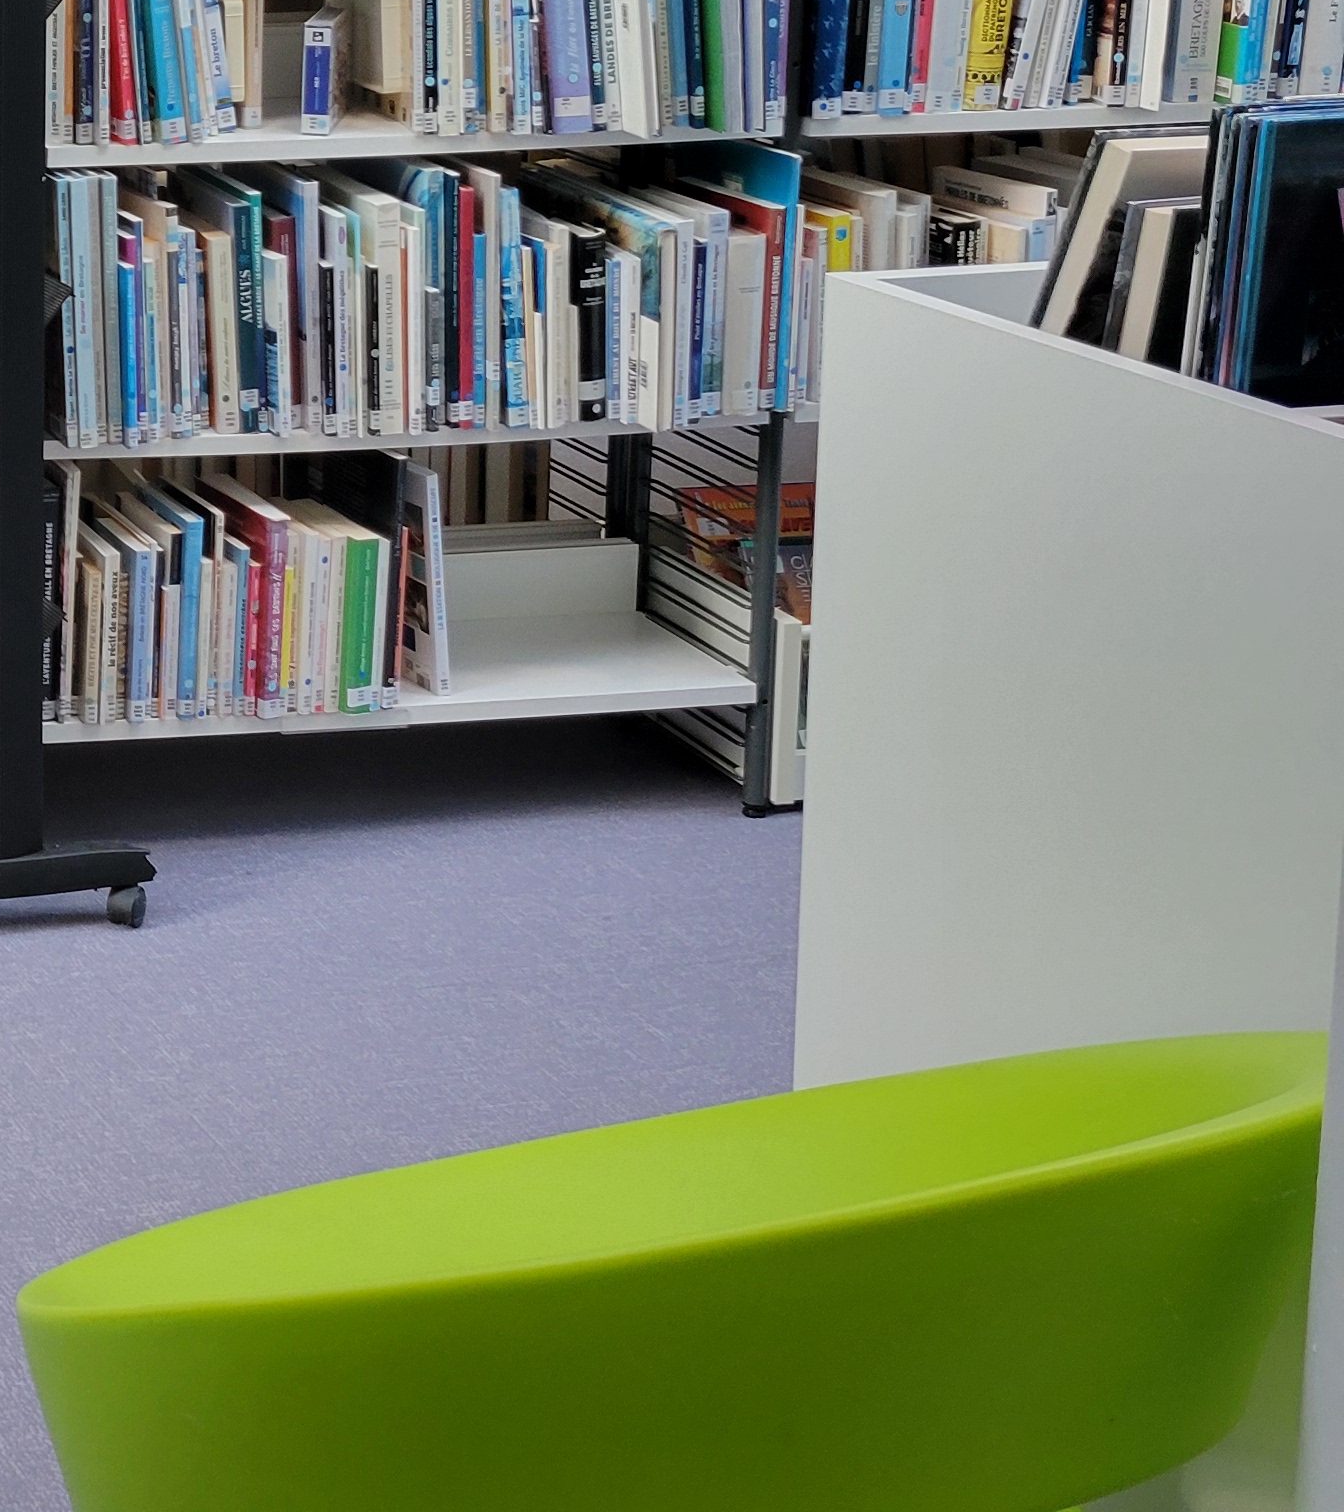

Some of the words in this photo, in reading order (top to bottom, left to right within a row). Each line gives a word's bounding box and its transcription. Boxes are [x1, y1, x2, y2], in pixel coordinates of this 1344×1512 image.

[1329, 11, 1338, 22] Le
[445, 7, 454, 57] CORSAIRES
[604, 22, 614, 42] DE
[867, 5, 882, 54] Finistère
[988, 34, 995, 42] DU
[209, 28, 221, 63] breton
[605, 45, 616, 84] LANDES
[867, 56, 879, 66] le
[211, 65, 222, 77] Le
[770, 255, 781, 294] BRETONNE
[239, 269, 253, 323] ALGUES
[613, 300, 620, 312] DU
[769, 296, 779, 330] MUSIQUE
[769, 332, 777, 341] DE
[339, 354, 345, 362] La
[613, 343, 620, 354] AU
[768, 343, 777, 370] MONDE
[44, 522, 53, 565] BRETAGNE
[44, 567, 53, 578] EN
[110, 571, 118, 599] aveux
[109, 601, 117, 619] nos
[108, 622, 117, 632] de
[107, 635, 116, 656] récif
[107, 659, 116, 667] le
